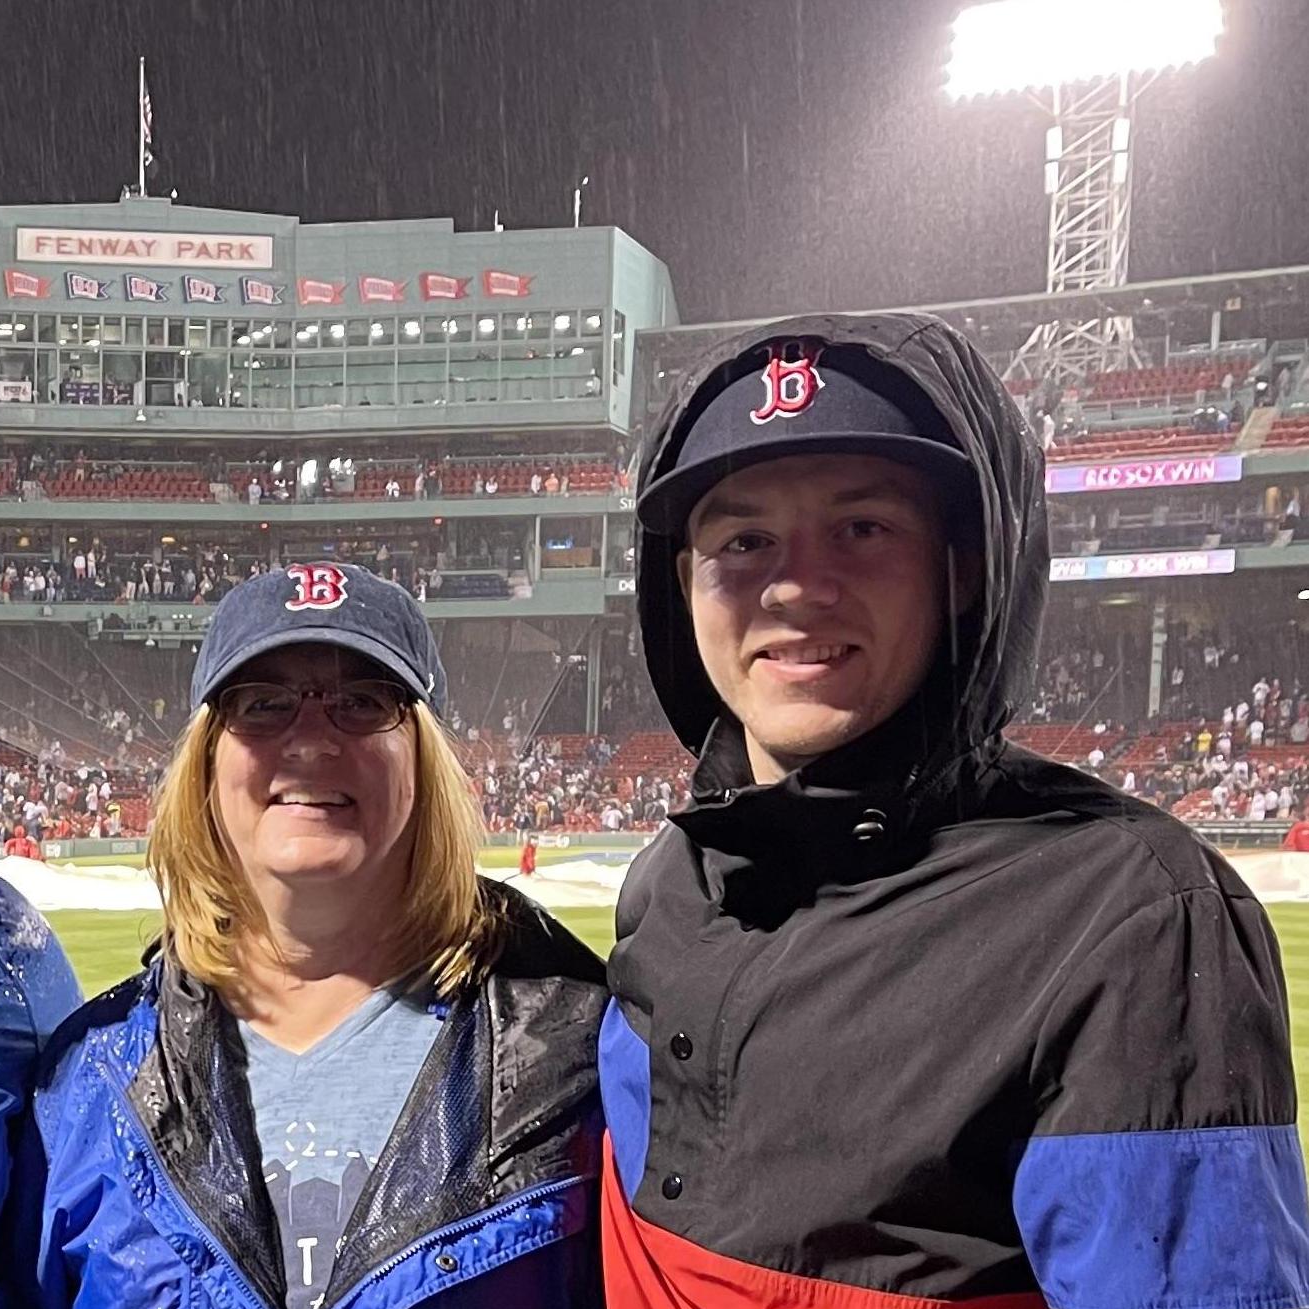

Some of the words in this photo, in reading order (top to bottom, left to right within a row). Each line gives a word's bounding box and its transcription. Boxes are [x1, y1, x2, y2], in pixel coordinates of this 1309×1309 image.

[35, 236, 157, 257] FENWAY
[176, 241, 254, 260] PARK
[750, 340, 825, 424] B
[1085, 469, 1121, 486] RED
[1125, 463, 1166, 483] SOX
[1171, 459, 1215, 480] WIN
[285, 561, 349, 611] B
